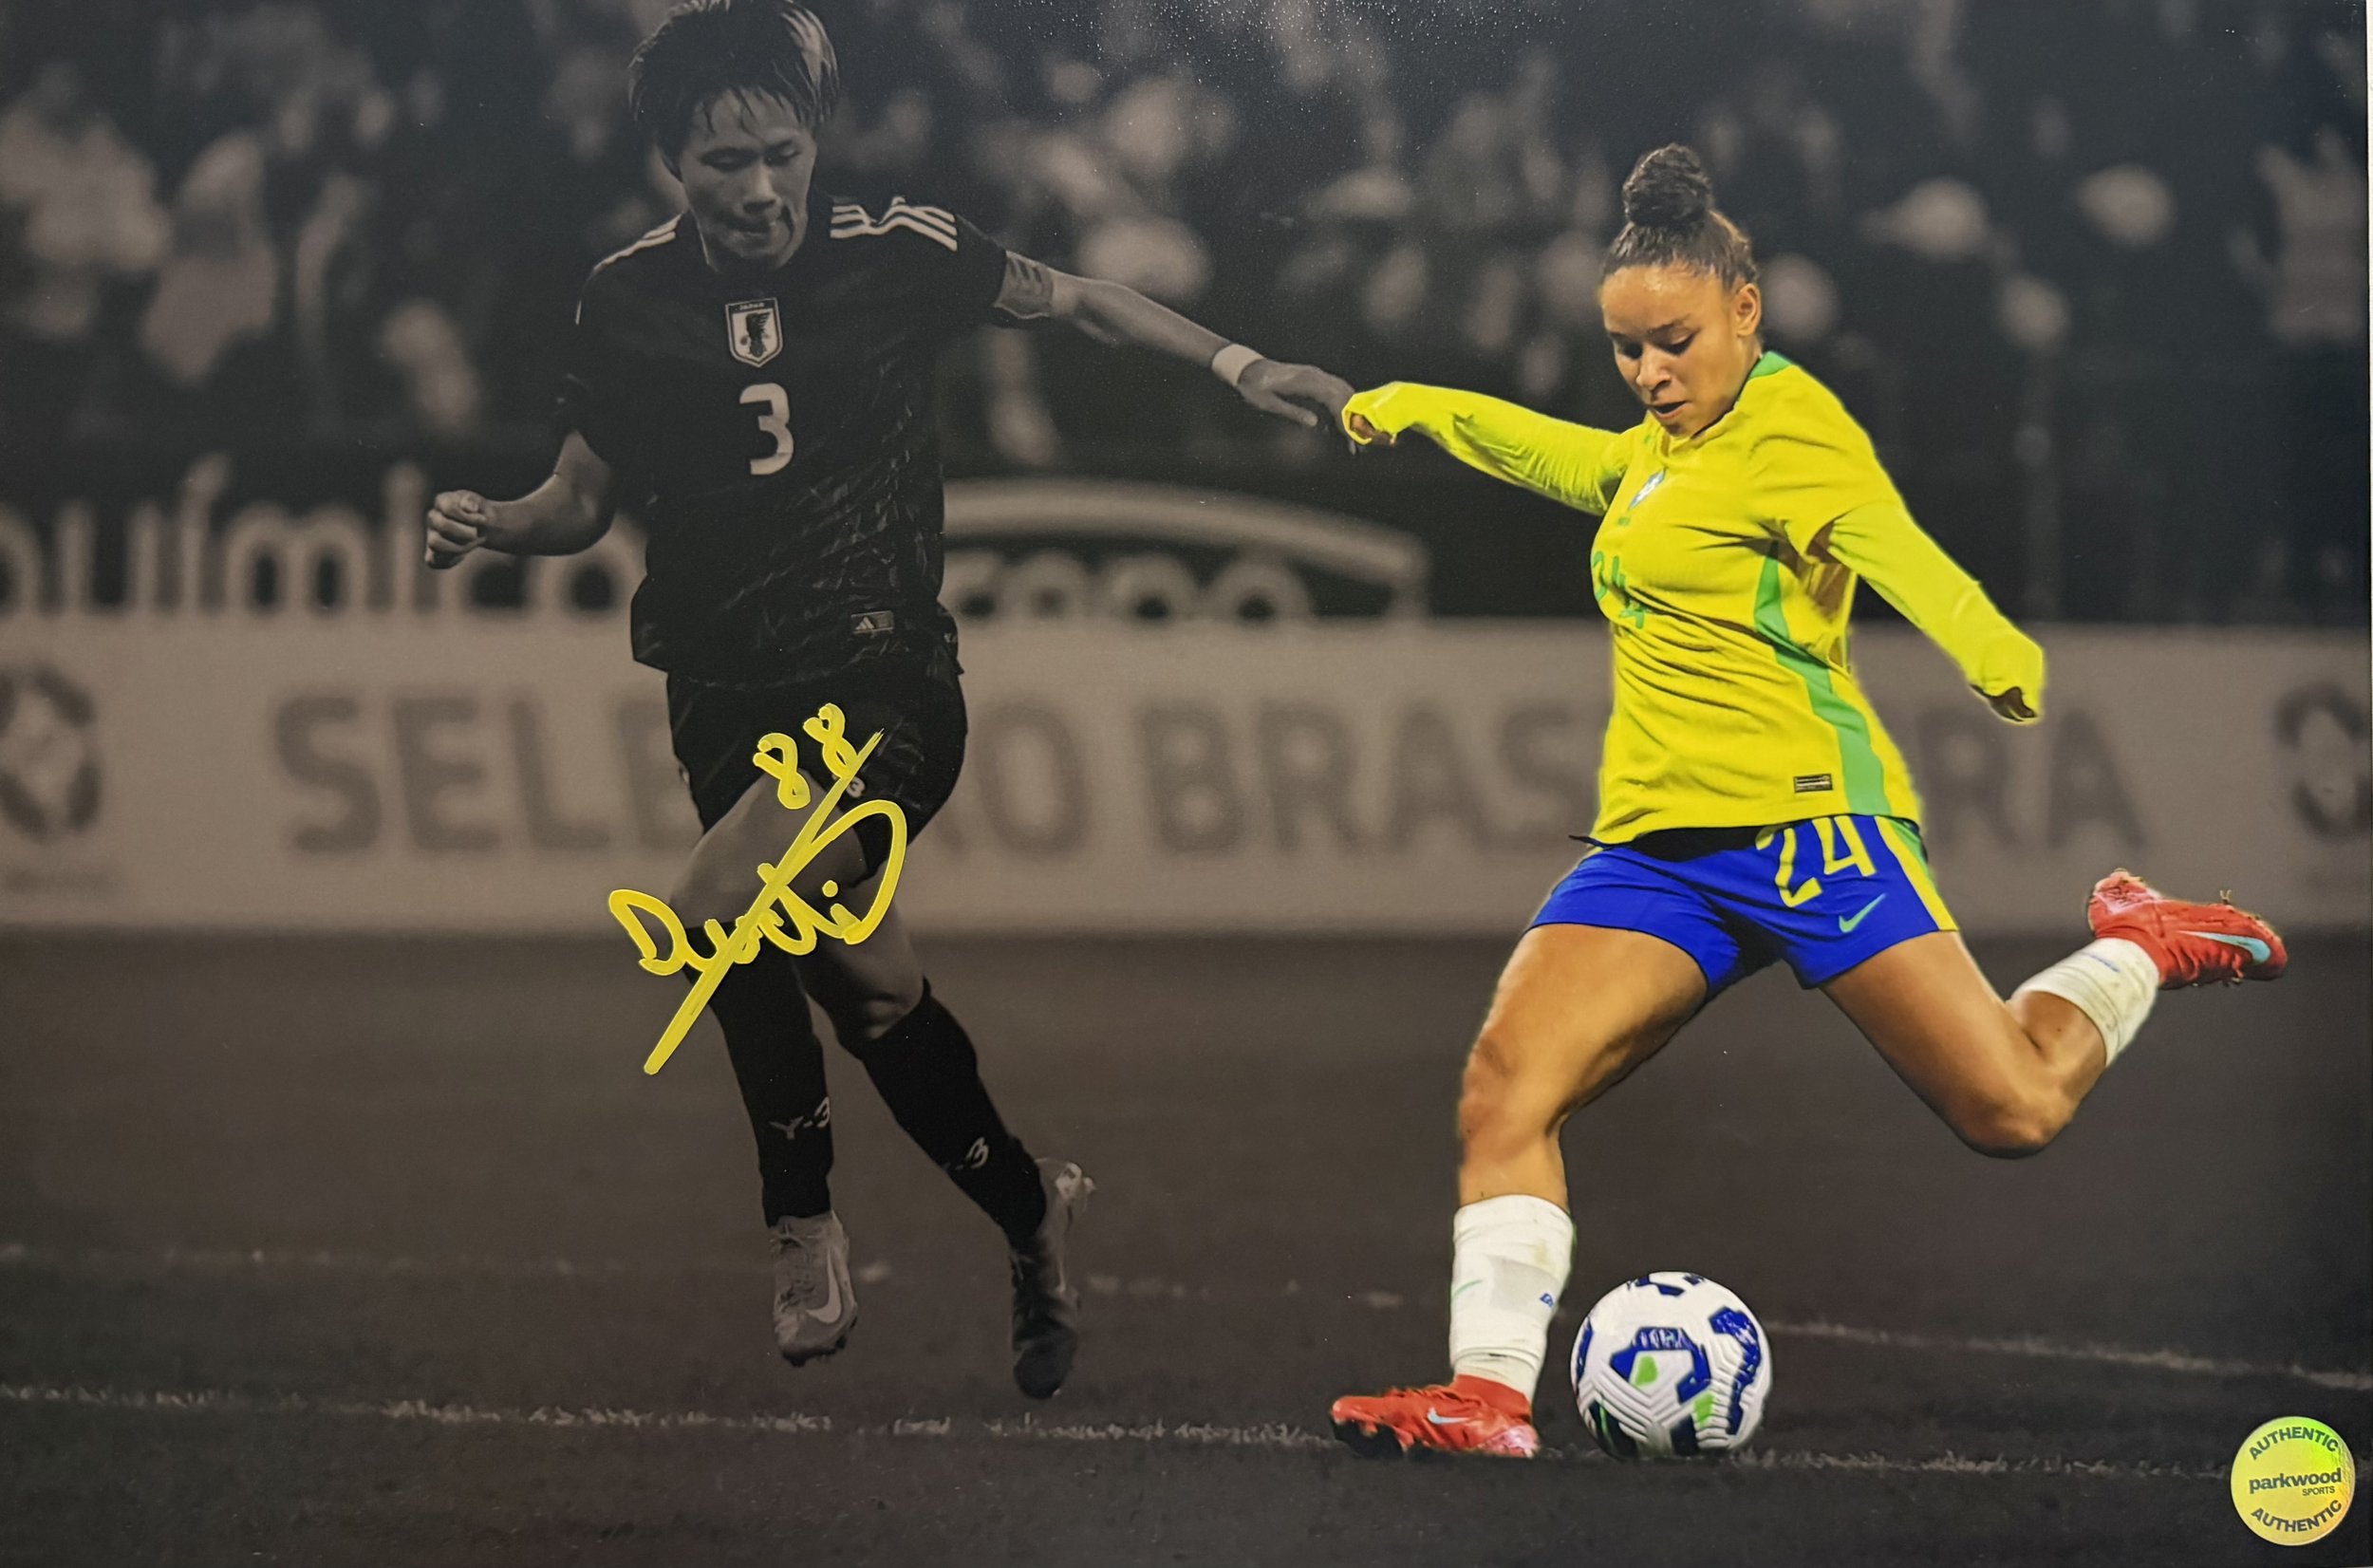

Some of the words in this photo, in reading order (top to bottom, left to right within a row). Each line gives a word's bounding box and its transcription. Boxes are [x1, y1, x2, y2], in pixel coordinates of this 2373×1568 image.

[738, 383, 794, 476] 3
[273, 691, 1090, 859] SELEO
[1755, 813, 1878, 908] 24
[2249, 1427, 2340, 1461] AUTHENTIC
[2249, 1467, 2343, 1495] parkwood
[2302, 1485, 2336, 1497] SPORTS
[2251, 1500, 2343, 1533] AUTHENTIC
